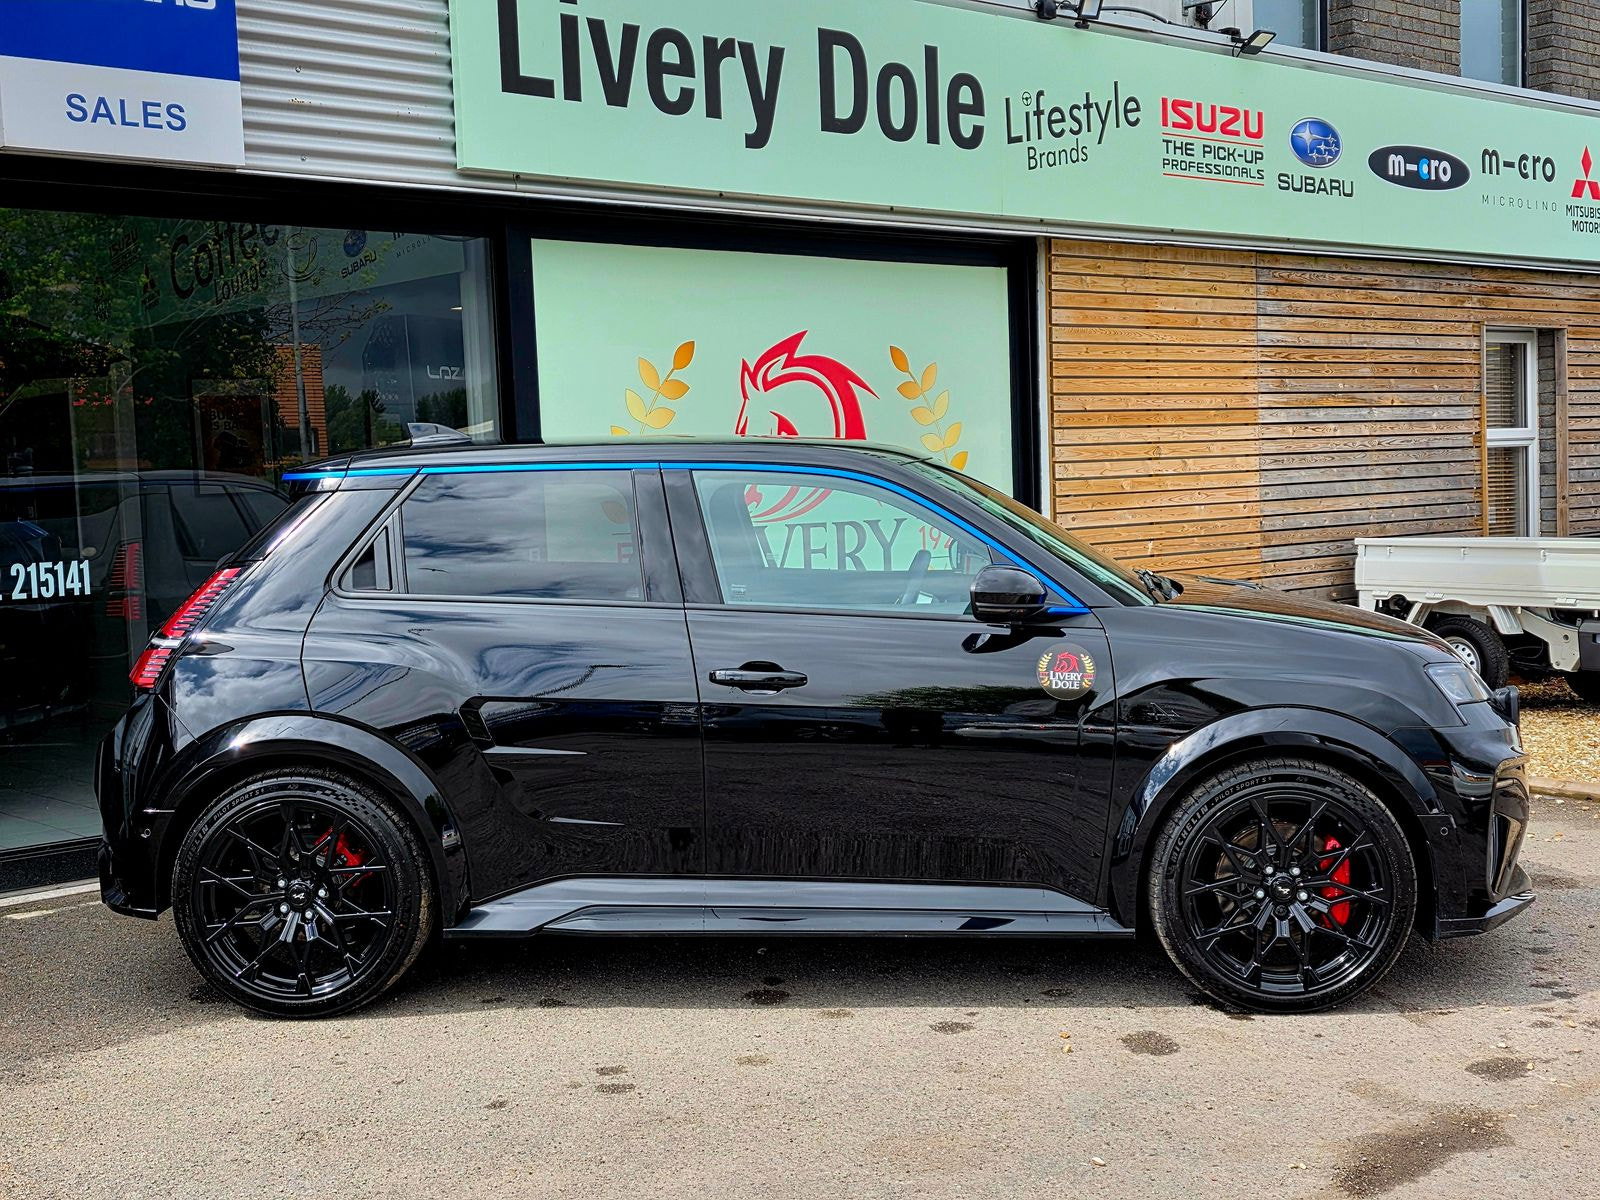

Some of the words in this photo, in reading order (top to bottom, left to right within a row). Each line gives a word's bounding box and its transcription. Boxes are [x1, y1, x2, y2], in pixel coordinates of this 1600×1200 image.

[498, 0, 785, 150] Livery
[817, 27, 985, 150] Dole
[65, 93, 187, 131] SALES
[1004, 80, 1141, 144] Lifestyle
[1161, 96, 1264, 139] ISUZU
[1027, 138, 1088, 170] Brands
[1162, 138, 1195, 157] THE
[1202, 143, 1264, 165] PICK-UP
[1162, 157, 1265, 180] PROFESSIONALS
[1277, 173, 1354, 198] SUBARU
[1482, 194, 1558, 212] MICROLINO
[1572, 219, 1600, 233] MOTOR
[340, 250, 377, 279] SUBARU
[10, 559, 91, 600] 215141
[1049, 671, 1083, 681] LIVERY
[1052, 680, 1080, 690] DOLE
[213, 804, 231, 821] PILOT
[231, 791, 255, 808] SPORT
[1171, 805, 1209, 863] MICHELIN
[1215, 789, 1234, 803] PILOT
[1236, 779, 1260, 791] SPORT
